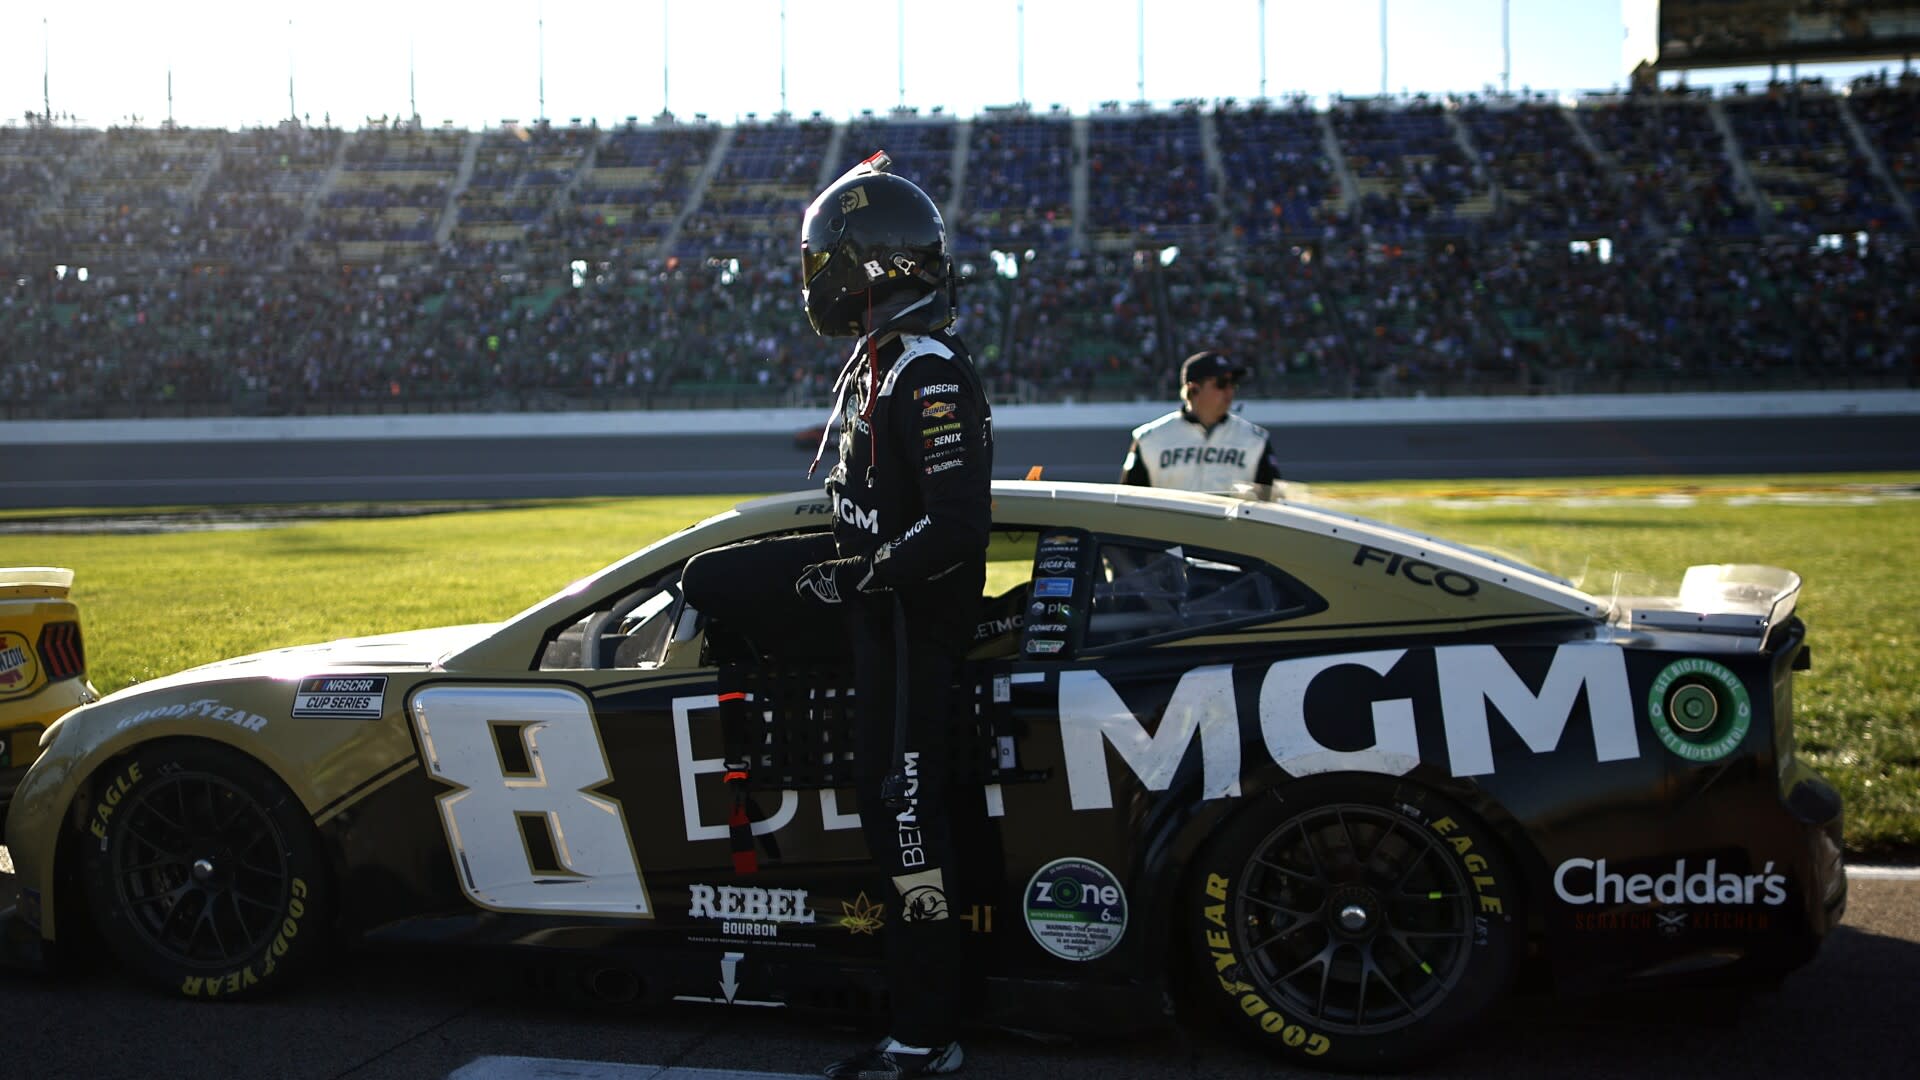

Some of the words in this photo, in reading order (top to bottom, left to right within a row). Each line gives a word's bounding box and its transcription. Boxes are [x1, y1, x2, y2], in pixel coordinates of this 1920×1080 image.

[923, 383, 959, 396] NASCAR
[922, 402, 956, 417] SUNOCO
[934, 432, 962, 447] SENIX
[1160, 447, 1247, 468] OFFICIAL
[836, 494, 878, 534] GM
[1038, 560, 1064, 569] LUCAS
[1352, 544, 1480, 598] FICO
[975, 614, 1024, 640] ETMG
[326, 680, 374, 691] NASCAR
[116, 698, 268, 733] GOODYEAR
[306, 697, 331, 708] CUP
[330, 697, 371, 709] SERIES
[672, 644, 1640, 841] BMGM
[90, 761, 144, 839] EAGLE
[406, 682, 654, 919] 8
[1430, 816, 1504, 915] EAGLE
[1553, 857, 1788, 906] Cheddar's
[688, 883, 816, 924] REBEL
[1036, 878, 1120, 907] zone
[722, 921, 777, 937] BOURBON
[1100, 907, 1111, 921] 6
[181, 877, 308, 997] GOODYEAR
[1203, 871, 1330, 1056] GOODYEAR
